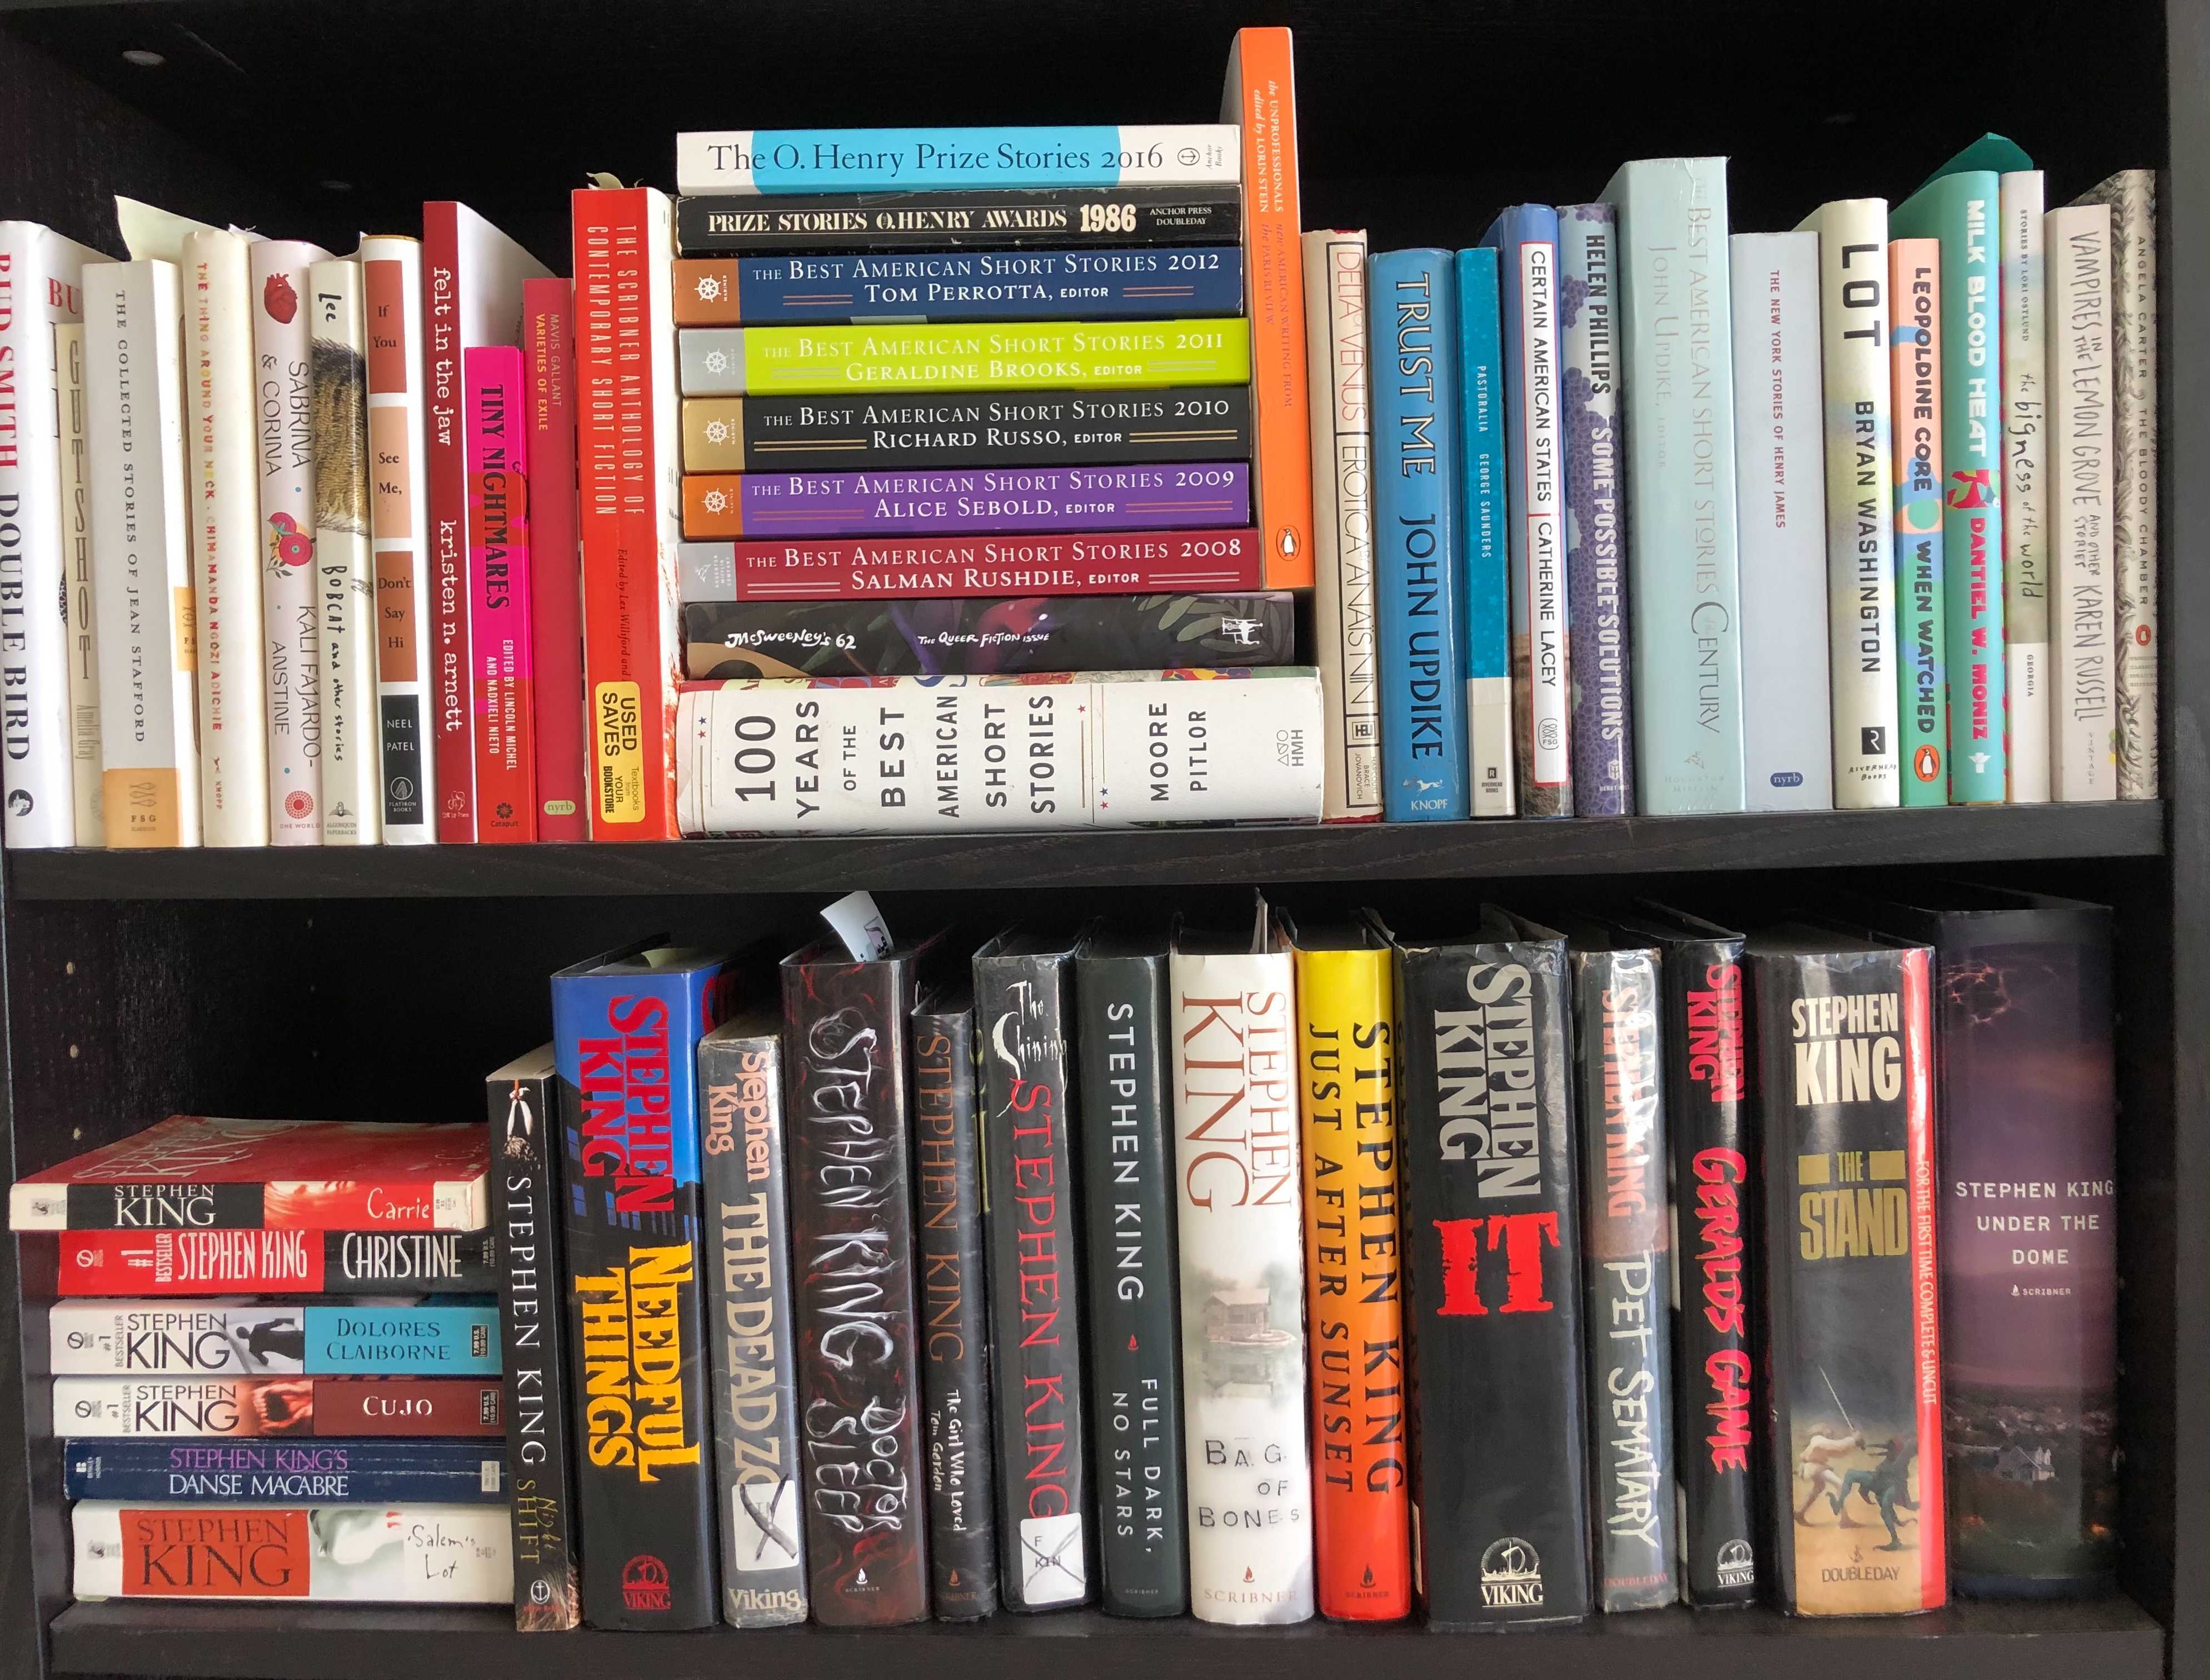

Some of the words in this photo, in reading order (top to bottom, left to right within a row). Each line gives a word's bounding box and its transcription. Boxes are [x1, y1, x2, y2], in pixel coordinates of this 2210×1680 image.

[1156, 217, 1206, 226] DOUBLEDAY
[1188, 207, 1212, 215] PRESS
[1967, 200, 1986, 263] MILK
[434, 267, 452, 316] felt
[753, 269, 782, 281] THE
[789, 260, 844, 280] BEST
[853, 258, 971, 278] AMERICAN
[980, 255, 1056, 276] SHORT
[1065, 253, 1158, 273] STORIES
[1168, 253, 1219, 271] 2012
[865, 284, 917, 303] TOM
[927, 283, 1054, 302] PERROTTA,
[1060, 287, 1109, 298] EDITOR
[1336, 252, 1364, 319] DELTA
[1531, 251, 1547, 328] CERTAIN
[1770, 270, 1780, 292] THE
[2137, 236, 2146, 303] ANGELA
[116, 290, 127, 328] THE
[378, 306, 389, 318] If
[1770, 299, 1781, 324] NEW
[1842, 244, 1881, 347] LOT
[1968, 276, 1987, 367] BLOOD
[435, 323, 447, 351] in
[536, 313, 547, 373] VARIETIES
[550, 314, 560, 350] MAVIS
[1396, 270, 1434, 404] TRUST
[1771, 330, 1782, 362] YORK
[1912, 267, 1933, 421] LEOPOLDINE
[2138, 313, 2147, 379] CARTER
[117, 339, 133, 453] COLLECTED
[436, 359, 453, 398] the
[537, 377, 547, 393] OF
[551, 356, 562, 407] GALLANT
[1339, 331, 1366, 422] VENUS
[1476, 366, 1488, 432] PASTORALIA
[1534, 337, 1550, 429] AMERICAN
[1772, 369, 1783, 419] STORIES
[289, 362, 311, 469] SABRINA
[433, 404, 454, 446] jaw
[481, 384, 505, 439] TINY
[538, 398, 548, 431] EXILE
[764, 415, 793, 426] THE
[800, 406, 854, 426] BEST
[862, 405, 980, 424] AMERICAN
[989, 402, 1064, 422] SHORT
[1072, 400, 1164, 419] STORIES
[1174, 400, 1230, 417] 2010
[873, 430, 977, 449] RICHARD
[987, 428, 1067, 447] RUSSO,
[1074, 433, 1123, 443] EDITOR
[1774, 426, 1784, 441] OF
[1968, 378, 1987, 457] HEAT
[2139, 408, 2148, 439] THE
[378, 452, 400, 464] See
[1400, 413, 1436, 479] ME
[1479, 453, 1490, 495] GEORGE
[1536, 437, 1552, 502] STATES
[1774, 447, 1785, 486] HENRY
[1913, 427, 1933, 492] CORE
[124, 464, 137, 542] STORIES
[1774, 490, 1785, 528] JAMES
[2138, 448, 2148, 514] BLOODY
[481, 447, 510, 609] NIGHTMARES
[1480, 501, 1492, 558] SAUNDERS
[127, 554, 137, 575] OF
[206, 516, 218, 614] CHIMAMANDA
[1399, 513, 1439, 618] JOHN
[1538, 521, 1555, 621] CATHERINE
[1969, 517, 1987, 619] DANTIEL
[2138, 524, 2148, 606] CHAMBER
[127, 587, 140, 635] JEAN
[208, 622, 220, 665] NGOZI
[502, 639, 514, 673] EDITED
[1540, 630, 1557, 688] LACEY
[1972, 627, 1987, 656] W.
[131, 646, 144, 743] STAFFORD
[211, 671, 222, 731] ADICHIE
[503, 676, 515, 689] BY
[1408, 631, 1443, 761] UPDIKE
[1972, 663, 1988, 740] MONIZ
[2026, 654, 2034, 697] GEORGIA
[387, 719, 413, 729] NEEL
[503, 692, 516, 734] LINCOLN
[387, 742, 415, 751] PATEL
[505, 737, 517, 771] MICHEL
[735, 715, 776, 802] 100
[796, 701, 820, 819] YEARS
[880, 707, 906, 807] BEST
[936, 696, 960, 818] AMERICAN
[984, 703, 1007, 808] SHORT
[1029, 696, 1056, 813] STORIES
[1149, 703, 1169, 802] MOORE
[1188, 710, 1208, 791] PITLOR
[603, 766, 615, 814] BOOKSTORE
[615, 776, 624, 803] YOUR
[1411, 799, 1448, 811] KNOPF
[1772, 773, 1800, 785] nyrb
[547, 802, 573, 813] nyrb
[1686, 990, 1719, 1081] KING
[1791, 992, 1899, 1038] STEPHEN
[1107, 1003, 1140, 1183] STEPHEN
[1433, 1006, 1491, 1161] KING
[1466, 962, 1541, 1198] STEPHEN
[1794, 1036, 1902, 1106] KING
[577, 1037, 631, 1178] KING
[608, 994, 675, 1213] STEPHEN
[734, 1052, 770, 1183] Stephen
[1182, 990, 1250, 1214] KING
[916, 1036, 958, 1232] STEPHEN
[1352, 1021, 1398, 1304] STEPHEN
[113, 1197, 217, 1226] KING
[367, 1187, 430, 1221] Carrie
[1009, 1077, 1062, 1348] STEPHEN
[1798, 1187, 1909, 1262] STAND
[1977, 1216, 2051, 1232] UNDER
[2061, 1214, 2099, 1230] THE
[177, 1231, 256, 1281] STEPHEN
[261, 1229, 308, 1279] KING
[342, 1232, 463, 1279] CHRISTINE
[506, 1176, 540, 1349] STEPHEN
[1114, 1203, 1144, 1302] KING
[1433, 1210, 1561, 1316] IT
[2012, 1249, 2069, 1264] DOME
[926, 1253, 965, 1363] KING
[2022, 1287, 2071, 1296] SCRIBNER
[114, 1315, 124, 1368] BESTSELLER
[127, 1313, 227, 1331] STEPHEN
[127, 1331, 231, 1369] KING
[337, 1318, 441, 1338] DOLORES
[326, 1342, 451, 1361] CLAIBORNE
[574, 1267, 636, 1467] THINGS
[628, 1239, 701, 1484] NEEDFUL
[122, 1384, 133, 1433] BESTSELLER
[135, 1400, 240, 1432] KING
[136, 1384, 236, 1401] STEPHEN
[362, 1395, 433, 1416] CUJO
[516, 1367, 547, 1465] KING
[1111, 1392, 1130, 1432] NO
[1361, 1334, 1405, 1494] KING
[1025, 1373, 1071, 1519] KING
[1114, 1448, 1133, 1536] STARS
[137, 1517, 288, 1544] STEPHEN
[516, 1478, 541, 1565] SHIFT
[1034, 1535, 1042, 1547] F
[141, 1544, 292, 1588] KING
[425, 1553, 459, 1579] Lot
[1481, 1584, 1544, 1607] VIKING
